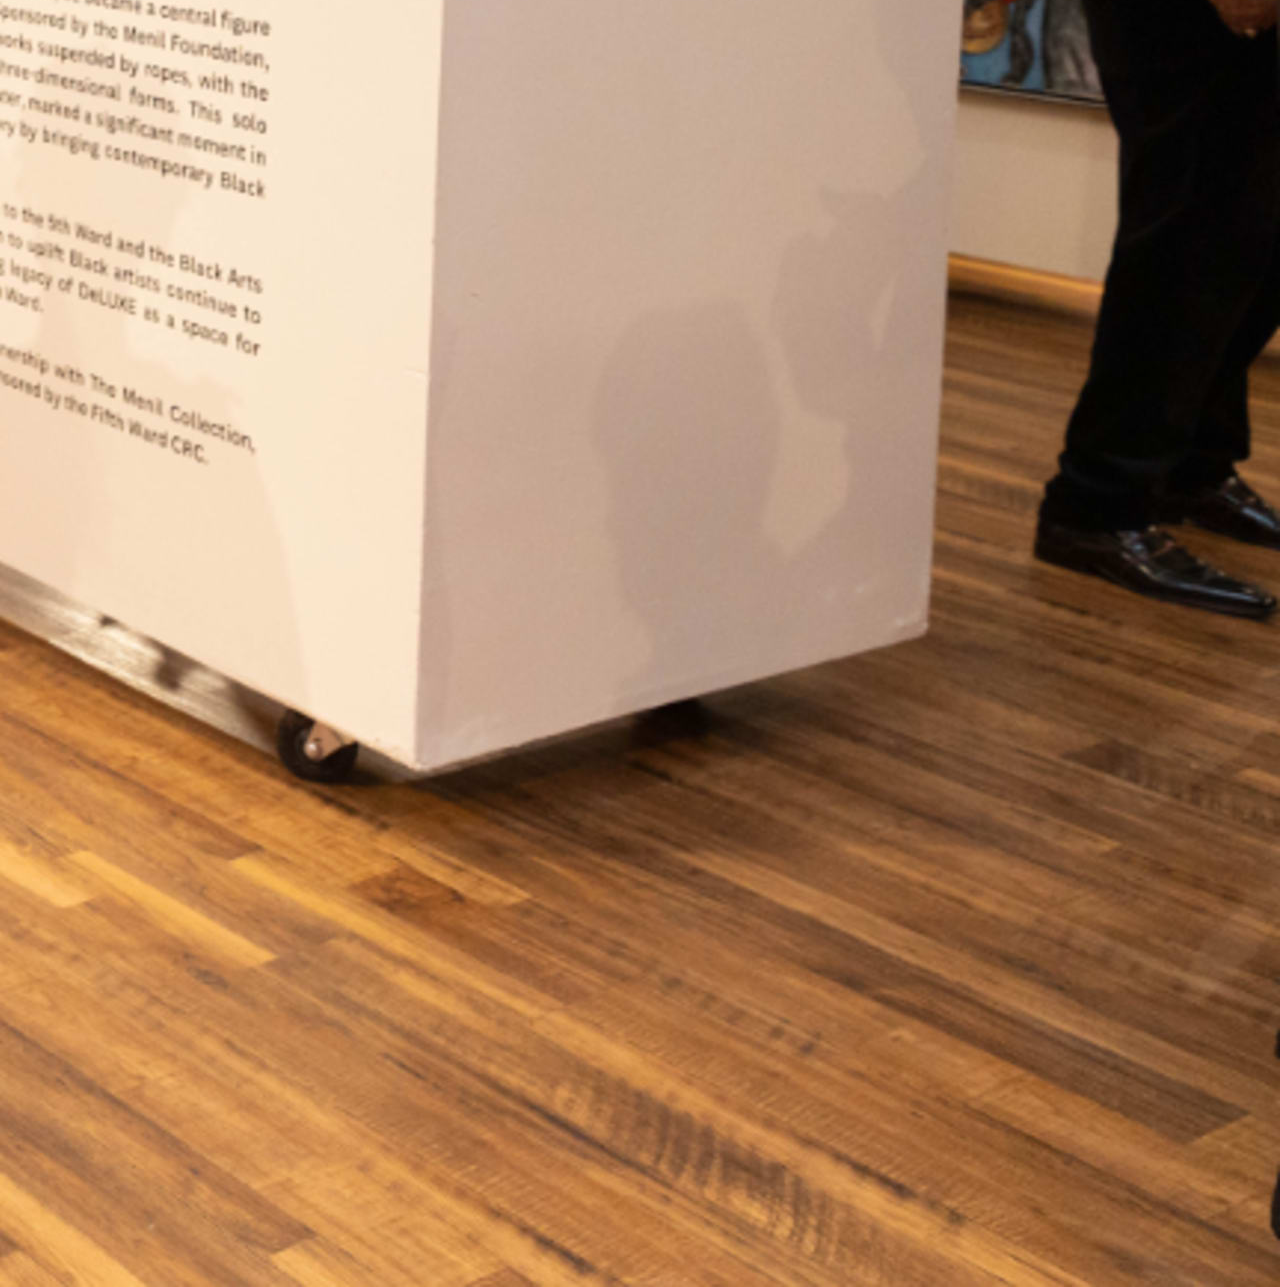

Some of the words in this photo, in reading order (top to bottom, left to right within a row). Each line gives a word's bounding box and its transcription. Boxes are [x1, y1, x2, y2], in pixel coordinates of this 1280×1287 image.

[70, 16, 88, 38] by
[94, 20, 118, 40] the
[123, 26, 166, 49] Menil
[170, 33, 273, 72] Foundation,
[147, 2, 155, 16] a
[160, 5, 216, 28] central
[220, 10, 270, 37] figure
[38, 42, 116, 69] suspended
[119, 55, 139, 78] by
[144, 64, 193, 87] ropes,
[199, 74, 233, 93] with
[241, 81, 269, 102] the
[85, 111, 92, 125] a
[96, 113, 173, 144] significant
[177, 133, 246, 161] moment
[250, 145, 266, 166] in
[129, 86, 179, 114] forms.
[190, 100, 222, 125] This
[232, 113, 267, 135] solo
[42, 126, 99, 160] bringing
[105, 145, 213, 189] contemporary
[220, 171, 264, 197] Black
[47, 213, 71, 235] 5th
[75, 223, 113, 249] Ward
[117, 238, 145, 259] and
[149, 245, 174, 267] the
[179, 254, 222, 281] Black
[228, 268, 263, 294] Arts
[69, 249, 108, 275] Black
[114, 267, 161, 293] artists
[166, 284, 237, 318] continue
[244, 305, 261, 324] to
[58, 277, 73, 293] of
[78, 281, 136, 315] DeLUXE
[144, 307, 160, 324] as
[167, 314, 175, 329] a
[182, 319, 229, 346] space
[235, 332, 259, 356] for
[44, 386, 61, 410] by
[64, 395, 88, 416] the
[90, 403, 124, 431] Fifth
[128, 420, 168, 448] Ward
[171, 435, 208, 463] CRC.
[54, 366, 84, 385] with
[91, 373, 116, 399] The
[122, 387, 163, 416] Menil
[169, 405, 257, 454] Collection,
